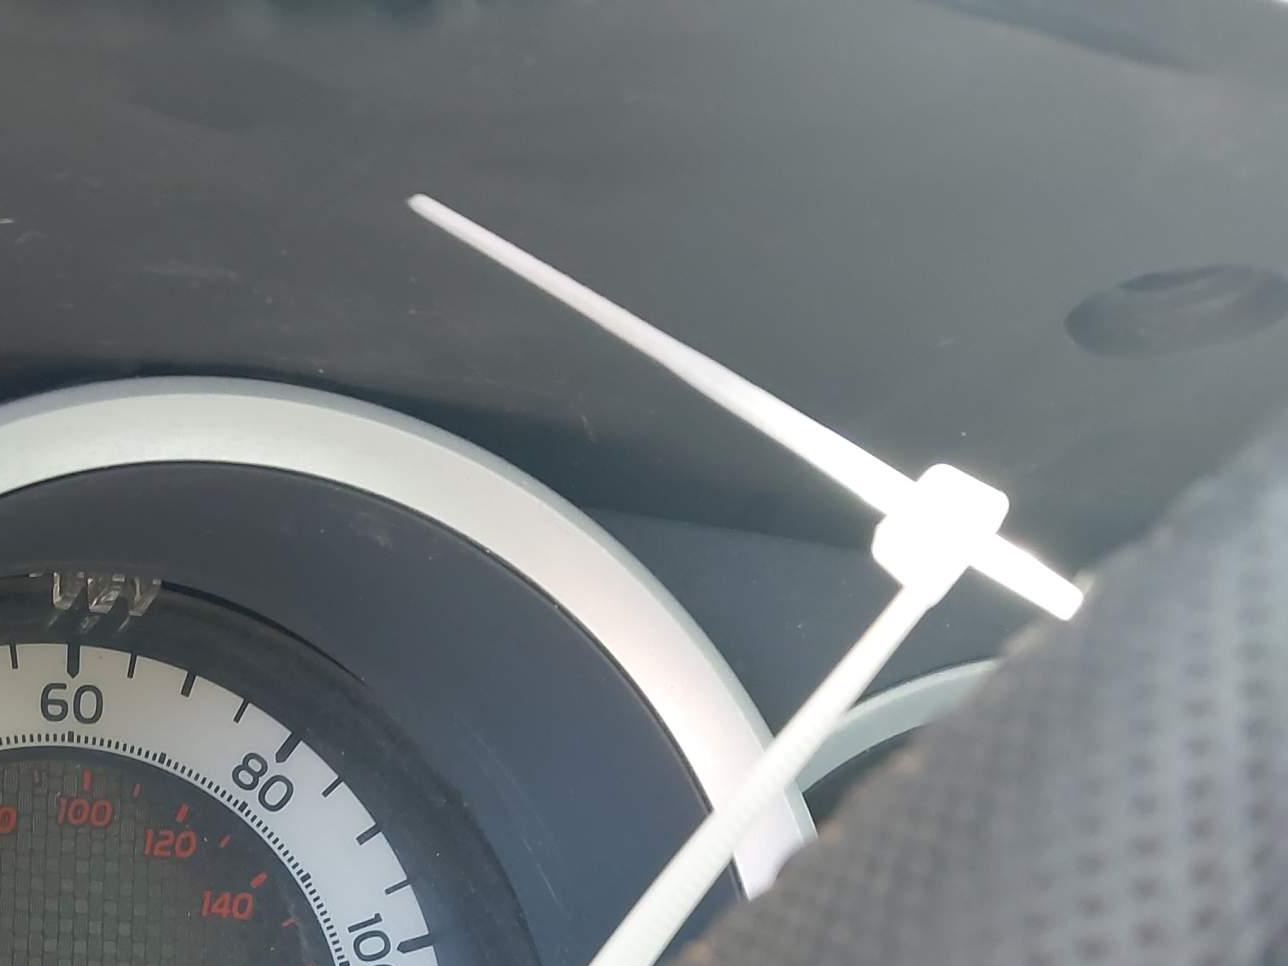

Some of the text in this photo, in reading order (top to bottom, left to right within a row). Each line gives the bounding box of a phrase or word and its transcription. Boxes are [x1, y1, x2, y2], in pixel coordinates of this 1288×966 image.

[40, 683, 104, 724] 60
[231, 752, 294, 812] 80
[57, 798, 113, 829] 100
[143, 829, 197, 859] 120
[200, 890, 254, 921] 140
